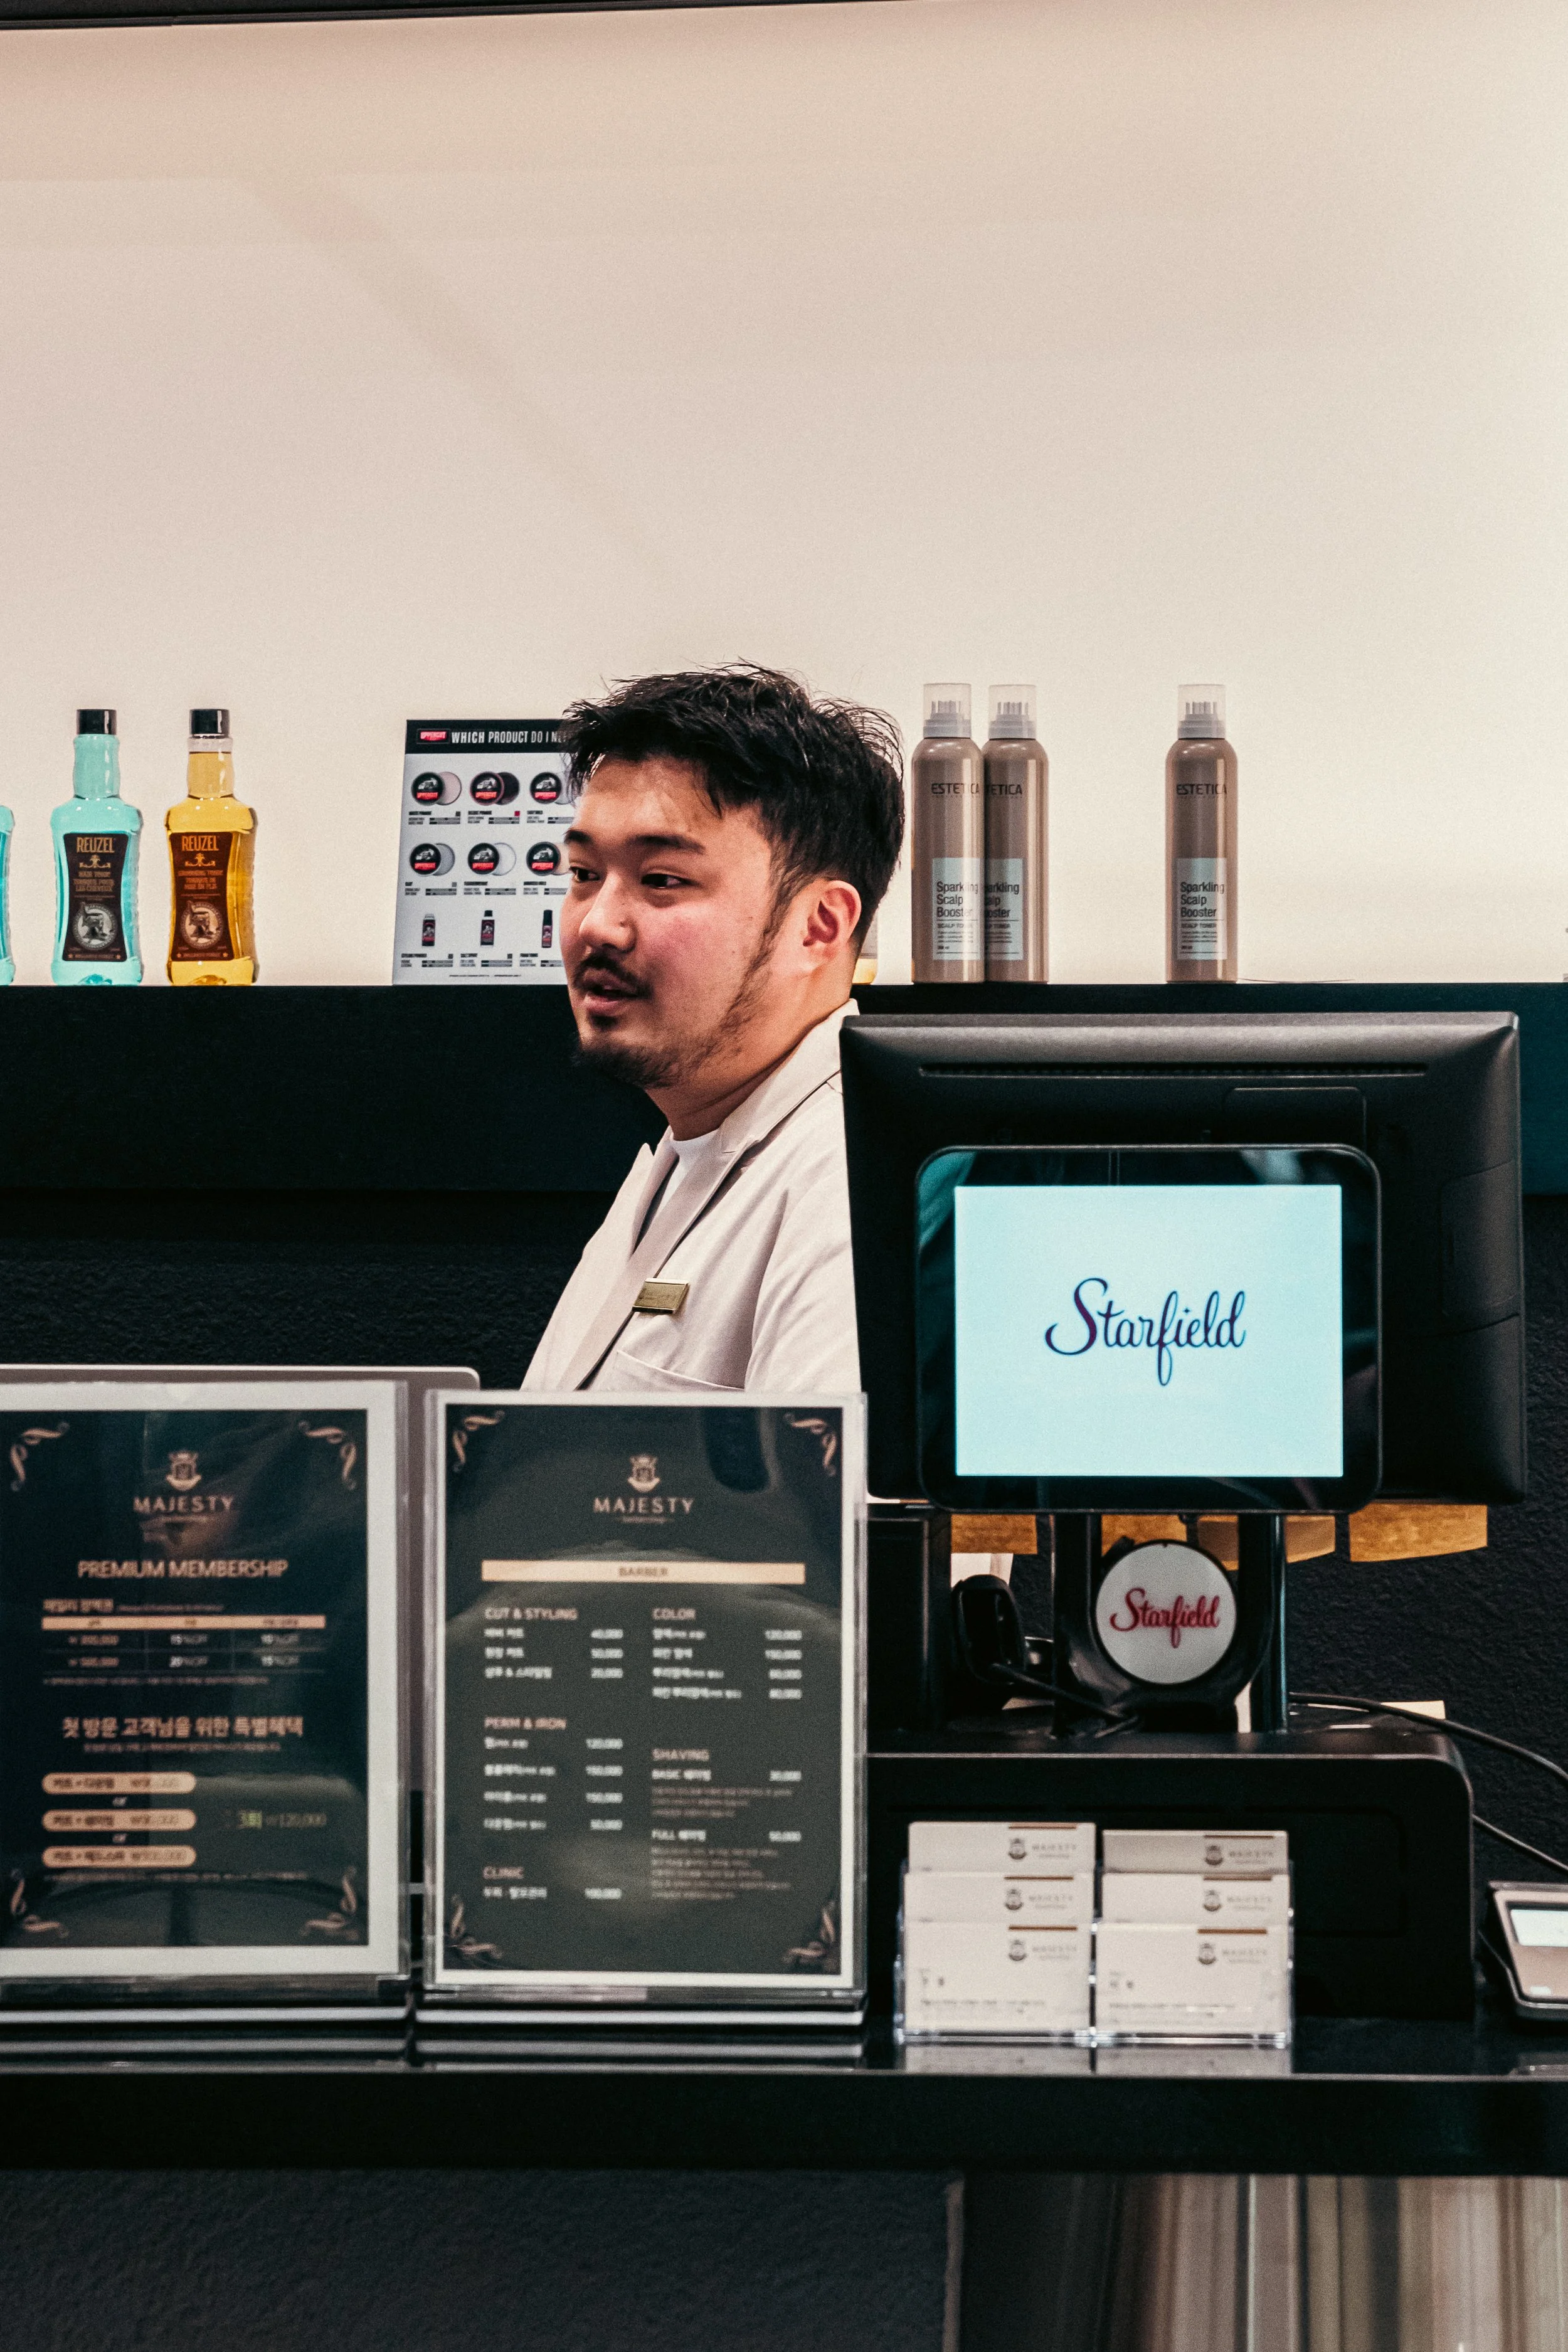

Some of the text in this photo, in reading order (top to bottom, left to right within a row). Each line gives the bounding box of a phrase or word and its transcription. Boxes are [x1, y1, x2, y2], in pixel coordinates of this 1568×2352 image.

[452, 731, 485, 743] WHICH
[488, 731, 528, 743] PRODUCT
[531, 731, 543, 743] DO
[546, 731, 549, 743] I
[1176, 783, 1227, 795] ESTETICA
[77, 837, 115, 853] REUZEL
[182, 835, 219, 852] REUZEL
[1180, 881, 1224, 895] Sparkling
[936, 894, 963, 906] Scalp
[1181, 894, 1207, 907] Scalp
[1181, 907, 1217, 918] Booster
[1045, 1278, 1246, 1385] Starfield
[133, 1496, 234, 1513] MAJESTY
[593, 1496, 694, 1514] MAJESTY
[78, 1560, 288, 1578] PREMIUM MEMBERSHIP
[618, 1567, 669, 1577] BARBER
[485, 1608, 578, 1619] CUT & STYLING
[653, 1608, 696, 1619] COLOR
[1110, 1587, 1220, 1649] Starfield
[591, 1629, 623, 1639] 40,000
[63, 1716, 304, 1738] 첫 방문 고객님을 위한 특별혜택
[485, 1717, 566, 1729] PERM & IRON
[652, 1749, 710, 1761] SHAVING
[652, 1769, 681, 1780] BASIC
[113, 1797, 127, 1807] or
[241, 1811, 262, 1829] 3회
[113, 1833, 127, 1843] or
[652, 1830, 677, 1841] FULL
[483, 1867, 524, 1880] CLINIC
